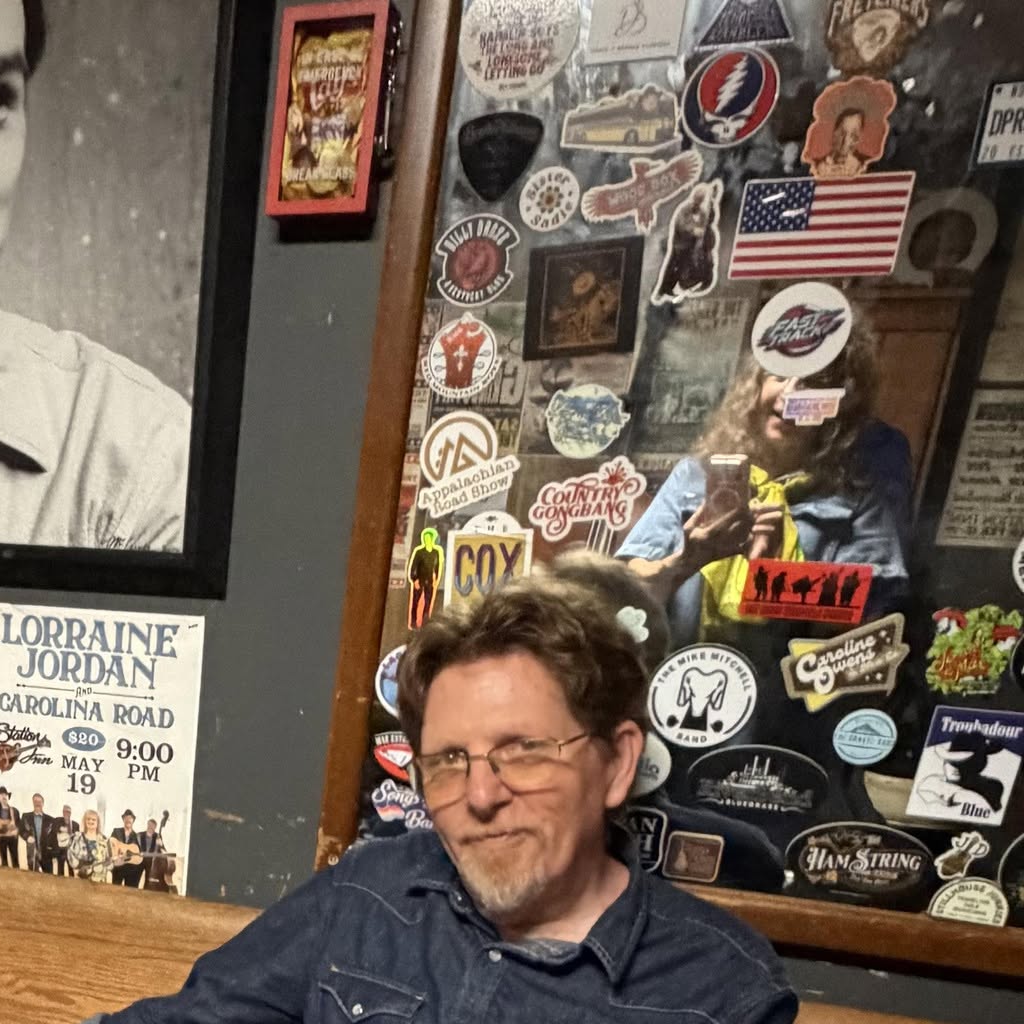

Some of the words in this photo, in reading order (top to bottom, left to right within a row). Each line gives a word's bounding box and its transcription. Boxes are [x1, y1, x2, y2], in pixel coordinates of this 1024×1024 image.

[526, 172, 570, 201] Sister
[530, 201, 573, 229] Sadie
[443, 222, 473, 252] BILLY
[774, 311, 823, 334] FAST
[432, 381, 482, 397] MOUNTAIN
[422, 459, 516, 505] Appalachian
[433, 492, 469, 514] Road
[471, 475, 509, 499] Show
[542, 477, 640, 506] COUNTRY
[455, 543, 522, 597] COX
[1, 613, 180, 659] LORRAINE
[17, 648, 157, 690] JORDAN
[658, 665, 676, 684] THE
[677, 652, 706, 666] MIKE
[711, 652, 752, 692] MITCHELL
[796, 635, 877, 683] Caroline
[814, 648, 876, 695] Owens
[76, 686, 93, 698] AND
[113, 703, 175, 729] ROAD
[940, 715, 1023, 738] Troubadour
[67, 730, 99, 746] $20
[116, 738, 174, 764] 9:00
[676, 732, 707, 744] BAND
[61, 755, 105, 773] MAY
[127, 763, 161, 782] PM
[67, 772, 97, 795] 19
[725, 799, 779, 811] BLUEGRASS
[960, 802, 991, 819] Blue
